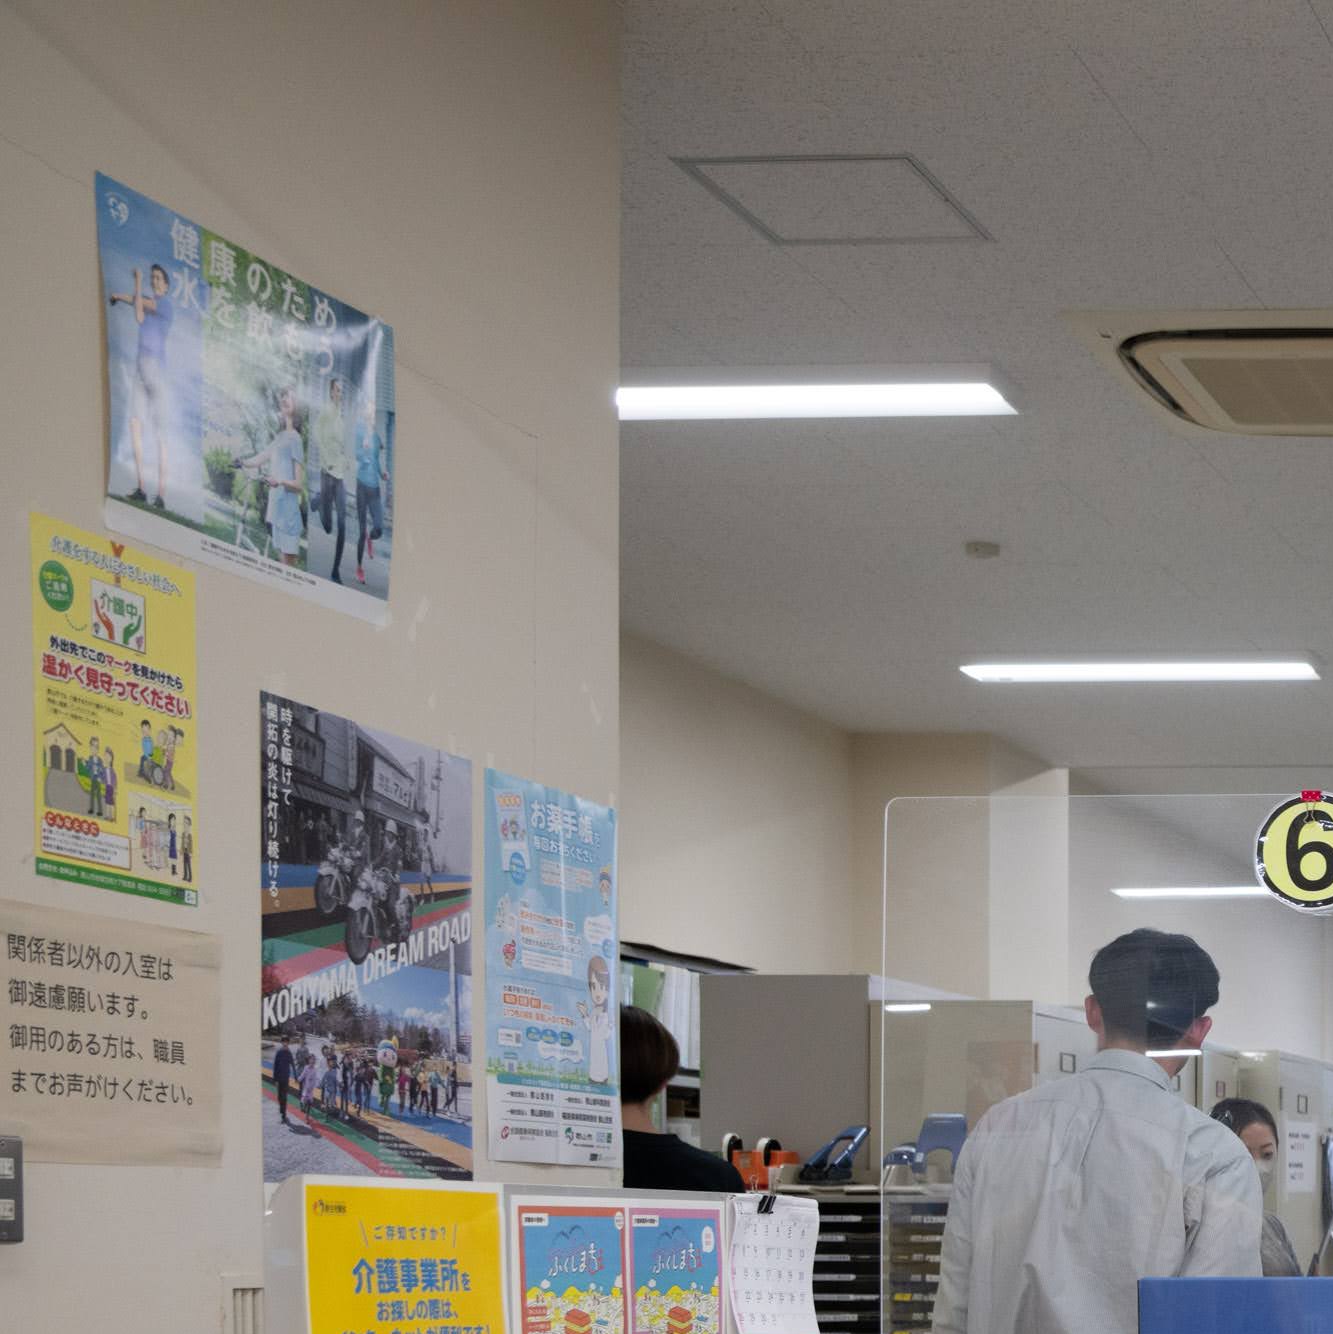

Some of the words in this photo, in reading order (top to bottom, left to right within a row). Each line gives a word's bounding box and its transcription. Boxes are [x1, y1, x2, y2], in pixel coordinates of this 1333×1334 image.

[171, 219, 337, 334] 健康のため
[100, 592, 139, 621] 介護中
[50, 635, 184, 690] 外出先でこのマークを見かけたら
[42, 652, 192, 720] 温かく見守ってください
[281, 706, 295, 806] 時を駆けて
[7, 934, 174, 981] 関係者以外の入室は
[263, 960, 362, 1031] KORIYAMA
[363, 928, 426, 986] DREAM
[427, 911, 471, 957] ROAD
[8, 978, 148, 1020] 御遠慮願います。
[9, 1024, 186, 1065] 御用のある方は、職員
[11, 1069, 193, 1106] までお声がけください。
[374, 1225, 446, 1240] ご存知ですか？
[352, 1257, 471, 1294] 介護事業所を
[377, 1299, 458, 1322] お探しの際は、
